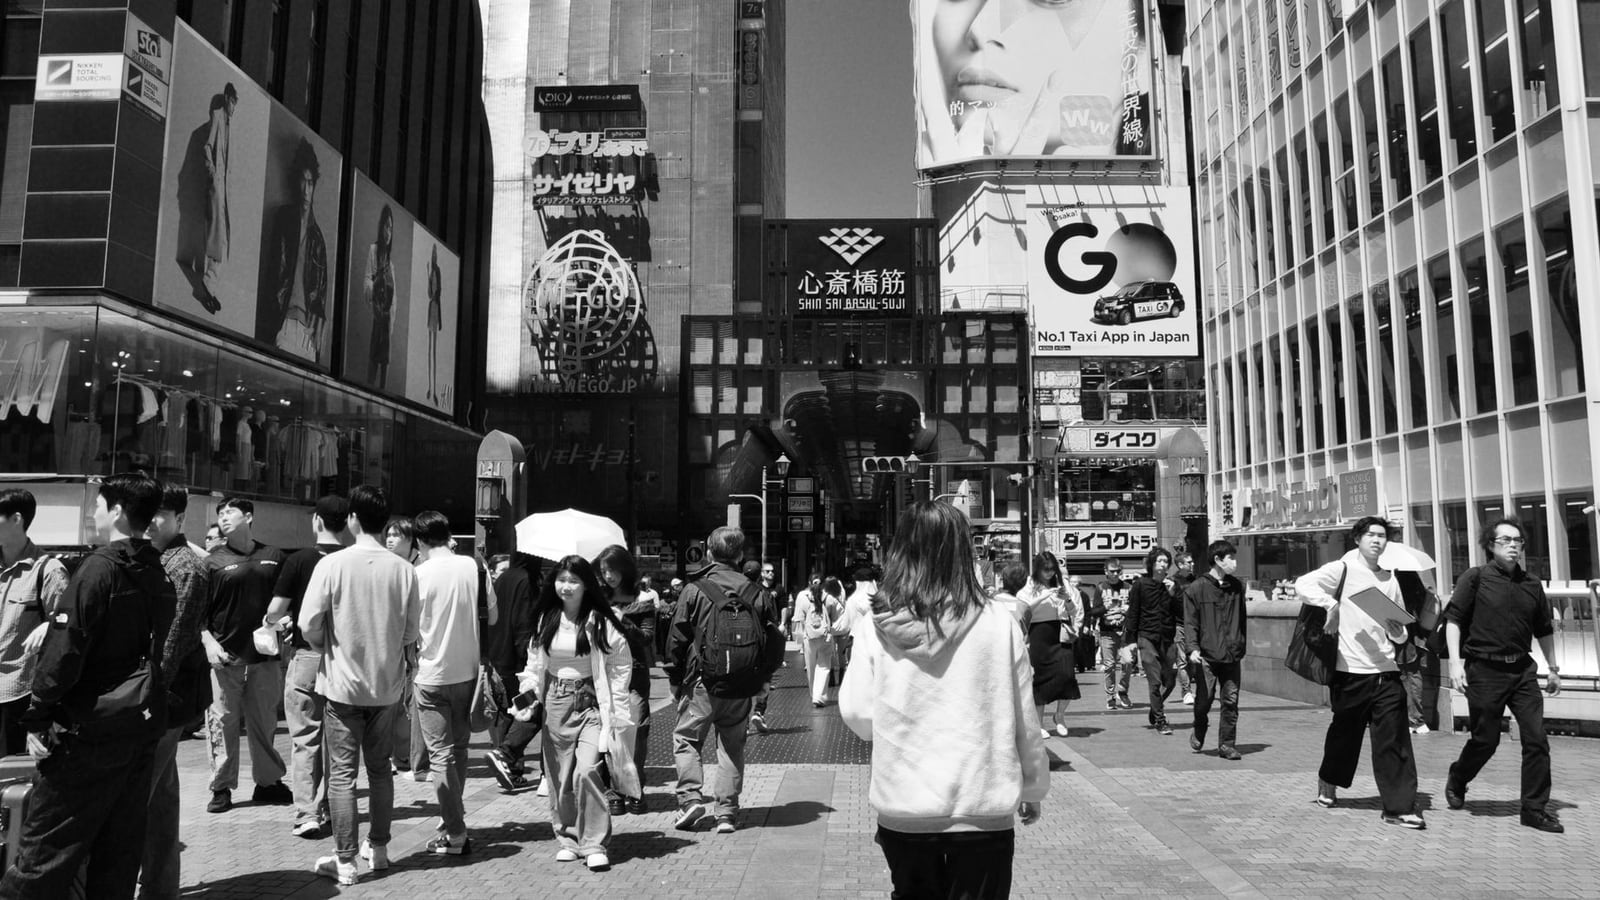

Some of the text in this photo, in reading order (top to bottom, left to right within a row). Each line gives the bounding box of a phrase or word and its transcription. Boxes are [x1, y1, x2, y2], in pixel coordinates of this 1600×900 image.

[534, 171, 636, 195] サイゼリヤ
[798, 268, 906, 296] 心斎橋筋
[1037, 330, 1190, 345] No.1 Taxi App in Japan
[1094, 431, 1157, 448] ダイコク
